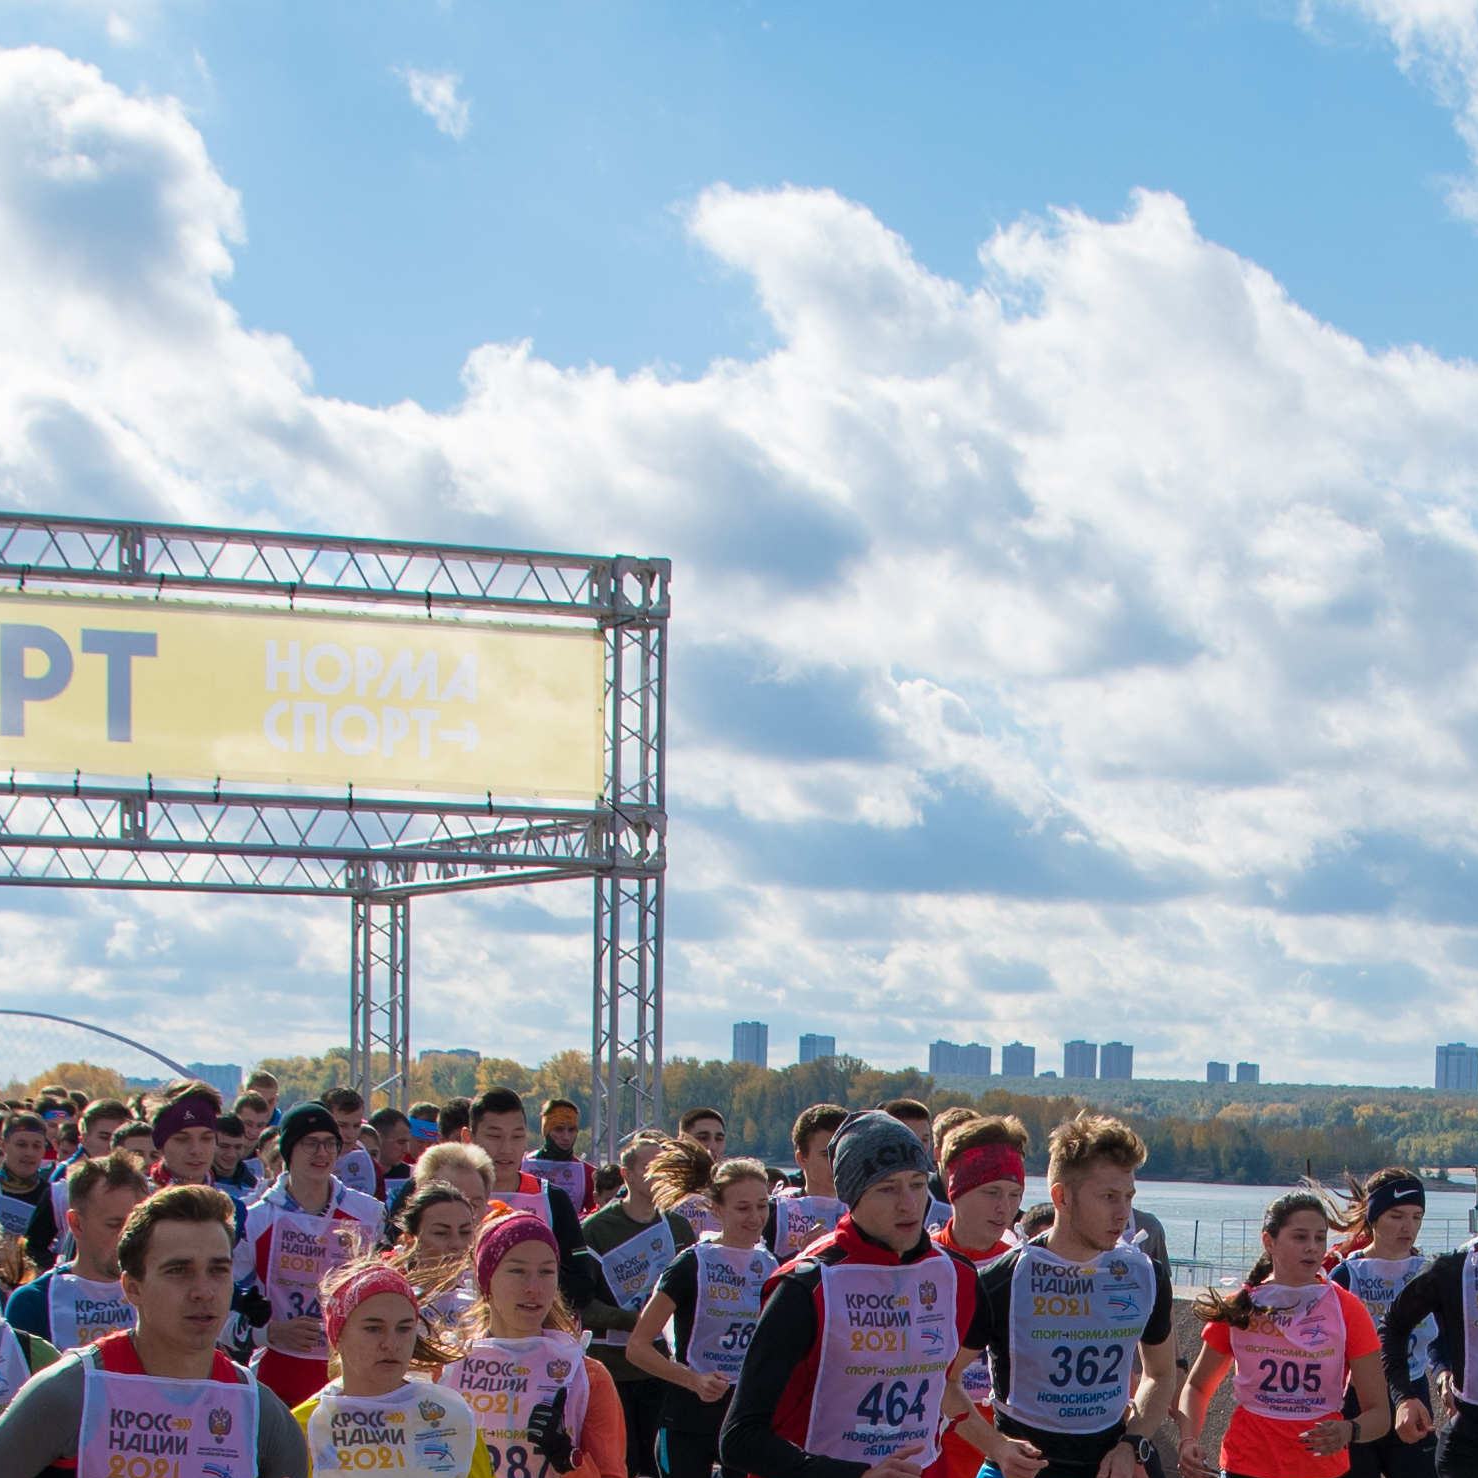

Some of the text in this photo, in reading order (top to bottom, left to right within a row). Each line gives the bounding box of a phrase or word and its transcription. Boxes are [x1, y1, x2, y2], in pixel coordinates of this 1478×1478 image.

[265, 640, 478, 703] НОРМА
[263, 700, 440, 759] СПОРТ
[282, 1231, 318, 1243] КРОСС
[281, 1242, 326, 1257] НАЦИИ
[280, 1255, 319, 1273] 2021
[613, 1255, 639, 1275] КРОСС
[616, 1260, 650, 1283] НАЦИИ
[1031, 1262, 1080, 1278] КРОСС
[707, 1271, 746, 1287] НАЦИИ
[1031, 1278, 1094, 1295] НАЦИИ
[846, 1293, 895, 1310] КРОСС
[1033, 1295, 1090, 1316] 2021
[76, 1308, 132, 1325] НАЦИИ
[849, 1311, 911, 1329] НАЦИИ
[850, 1330, 907, 1352] 2021
[1031, 1326, 1142, 1340] СПОРТ НОРМА ЖИЗНИ
[463, 1358, 514, 1377] КРОСС
[845, 1366, 877, 1376] СПОРТ
[1048, 1344, 1124, 1387] 362
[459, 1373, 529, 1393] НАЦИИ
[1259, 1359, 1321, 1393] 205
[857, 1379, 929, 1426] 464
[1059, 1406, 1106, 1417] ОБЛАСТЬ
[110, 1408, 172, 1432] КРОСС
[331, 1411, 385, 1428] КРОСС
[109, 1430, 188, 1456] НАЦИИ
[332, 1428, 406, 1447] НАЦИИ
[337, 1447, 405, 1471] 2021
